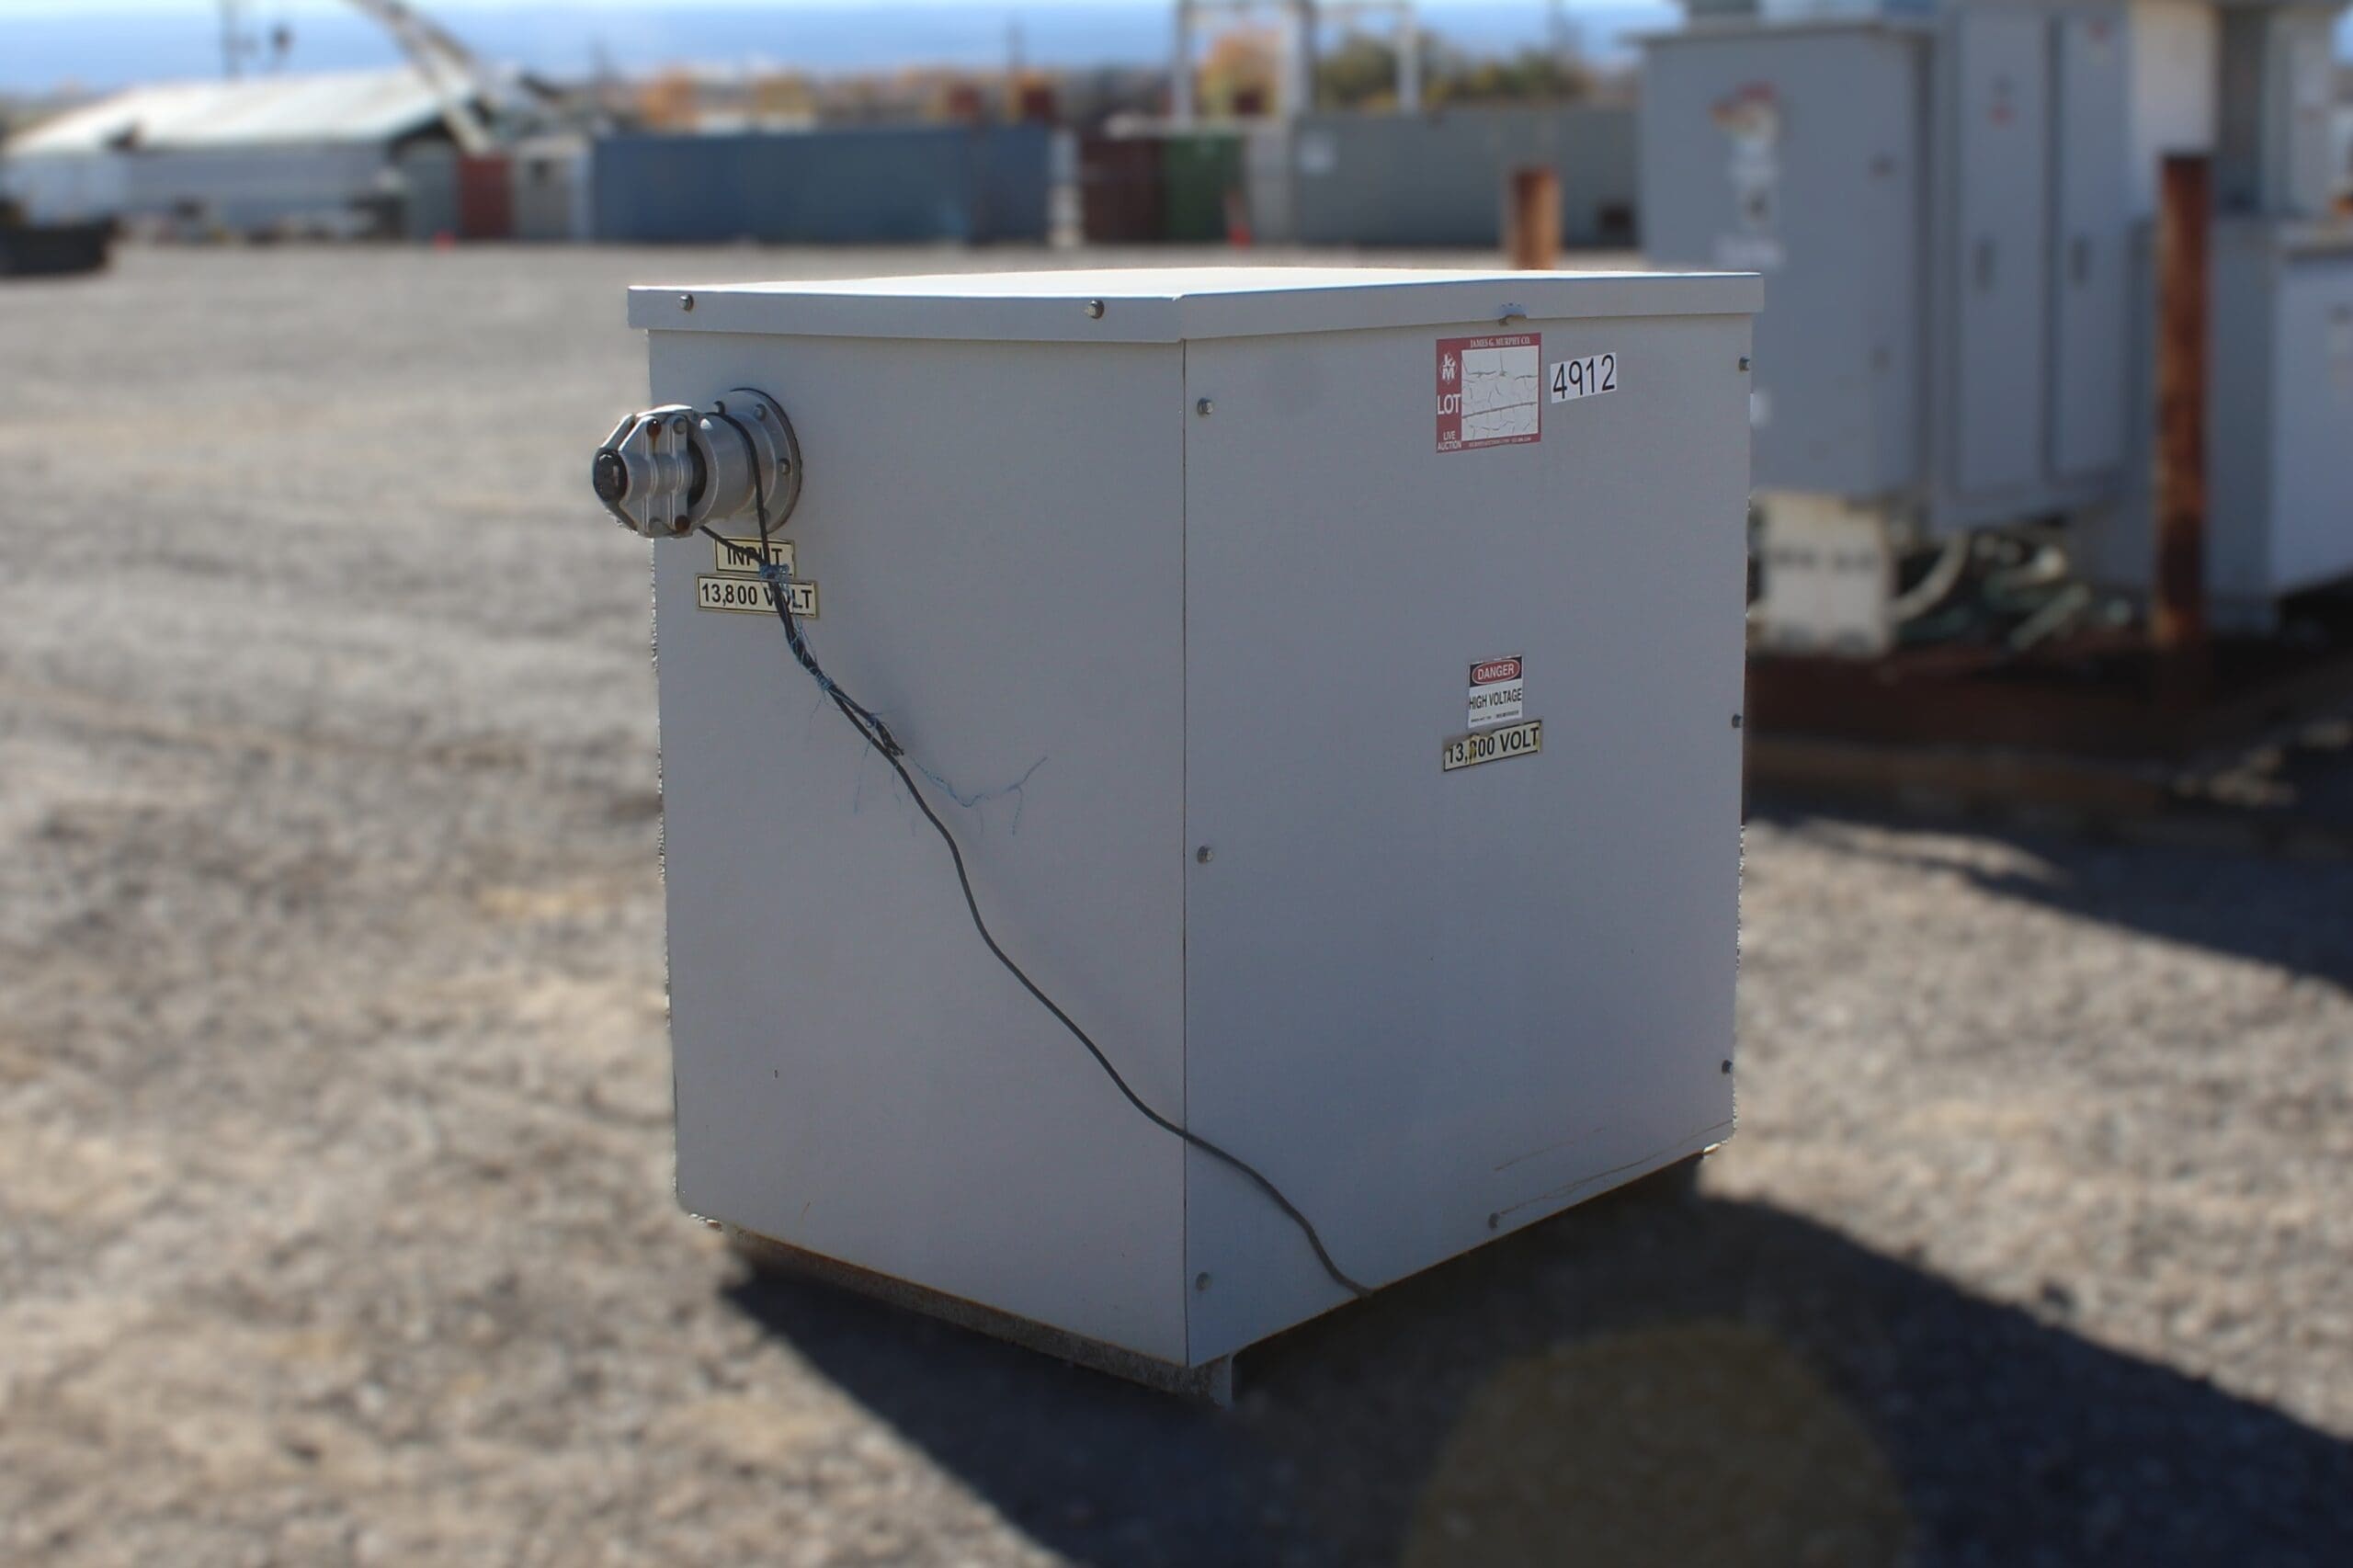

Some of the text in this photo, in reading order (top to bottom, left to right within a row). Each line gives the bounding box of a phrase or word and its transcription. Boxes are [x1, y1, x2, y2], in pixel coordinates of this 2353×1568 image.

[1552, 354, 1615, 399] 4912
[1437, 393, 1461, 415] LOT
[1438, 440, 1461, 450] AUCTION
[1443, 430, 1456, 440] LIVE
[727, 546, 783, 567] INPT
[701, 583, 757, 606] 13,800
[1477, 663, 1515, 680] DANGER
[1469, 687, 1522, 710] HIGH VOLTAGE
[1499, 726, 1540, 753] VOLT
